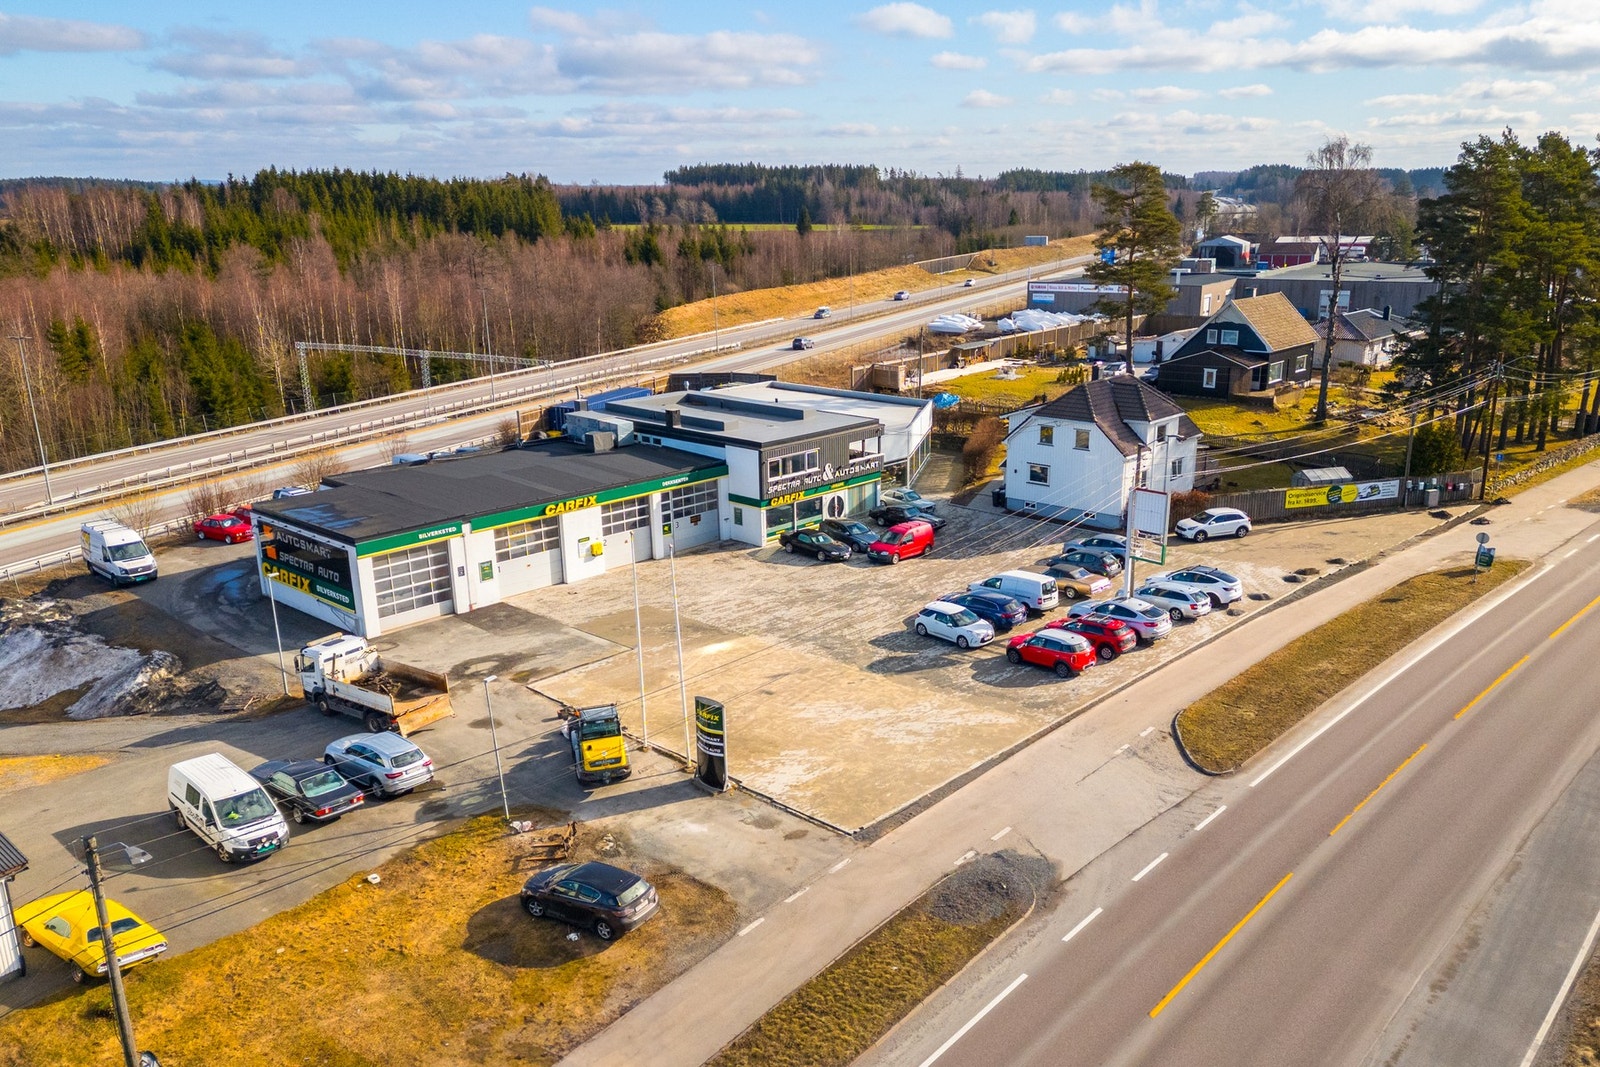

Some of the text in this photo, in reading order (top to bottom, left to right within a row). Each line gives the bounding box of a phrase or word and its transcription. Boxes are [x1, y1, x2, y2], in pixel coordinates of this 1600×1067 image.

[768, 480, 801, 494] SPECTRA
[804, 475, 822, 485] AUTO
[835, 461, 879, 478] AUTOSMART
[545, 495, 597, 515] CARFIX
[771, 491, 805, 507] CARFIX
[418, 526, 457, 539] BILVERKSTED
[276, 532, 332, 559] AUTOSMART
[262, 562, 311, 594] CARFIX
[279, 552, 340, 582] SPECTRA AUTO
[316, 584, 350, 604] BILVERKSTED
